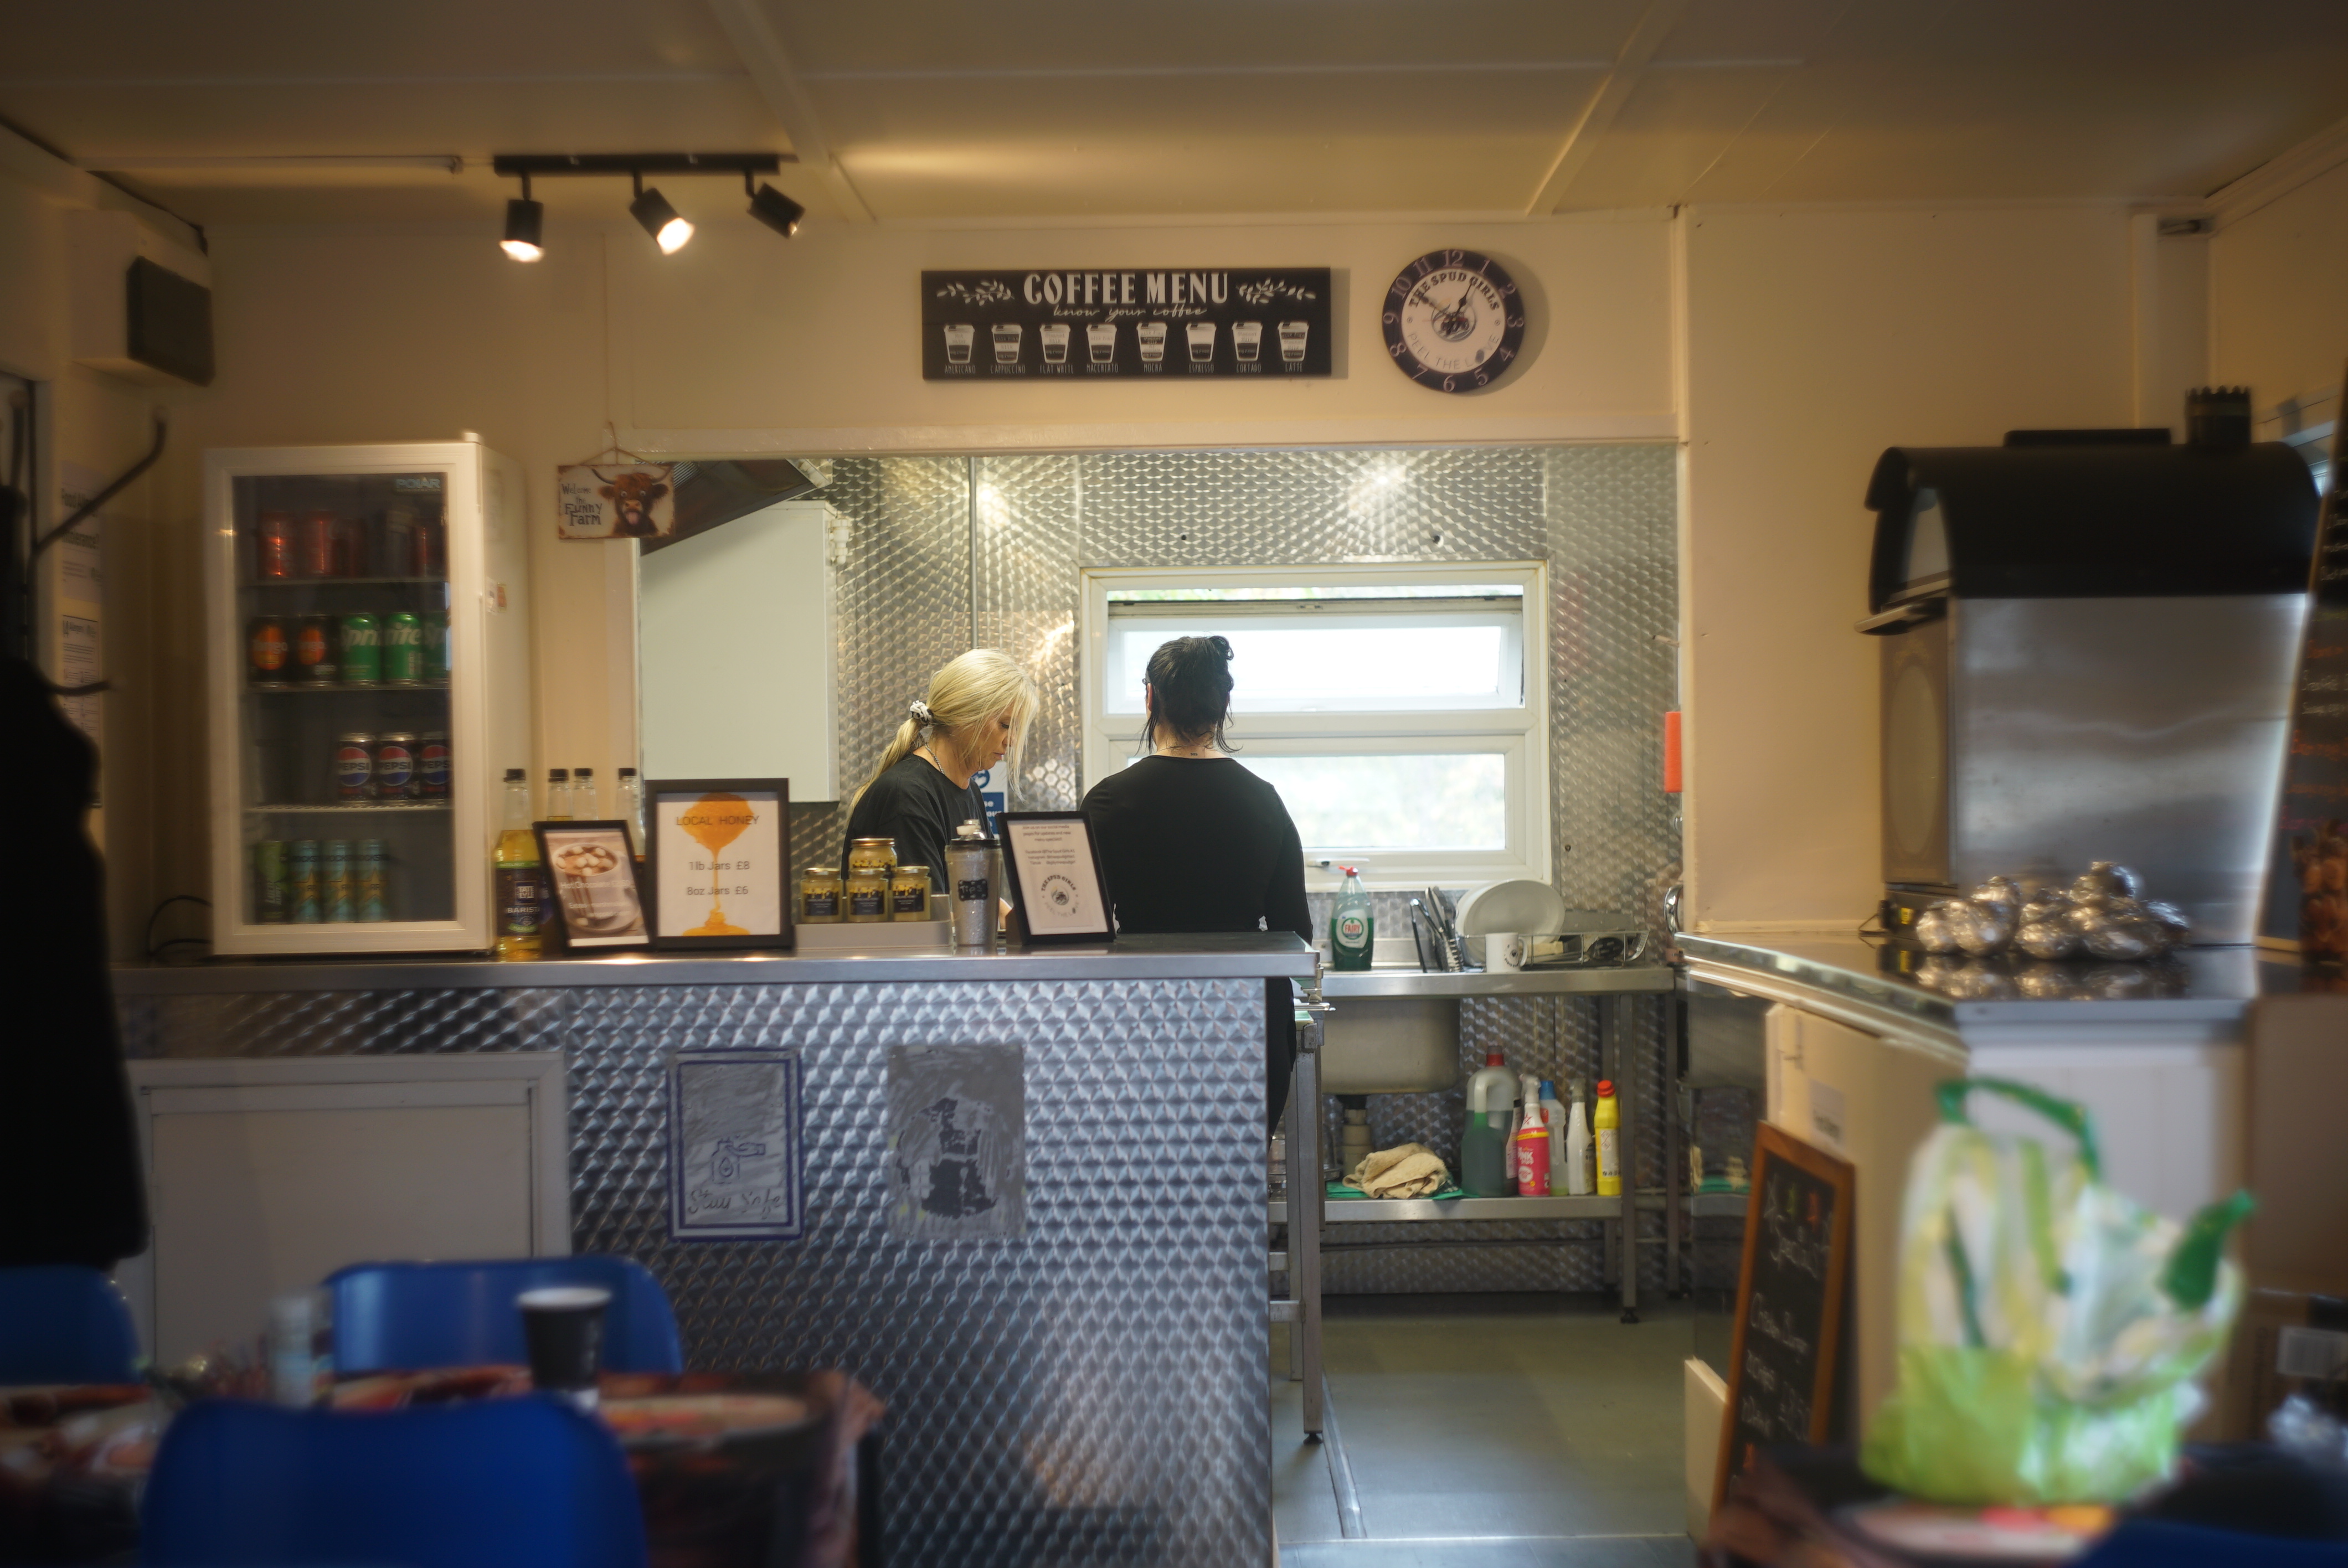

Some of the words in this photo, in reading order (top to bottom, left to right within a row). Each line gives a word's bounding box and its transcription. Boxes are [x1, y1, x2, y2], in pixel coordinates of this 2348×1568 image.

[1442, 249, 1464, 268] 12
[1413, 256, 1434, 278] 11
[1023, 273, 1136, 305] COFFEE
[1146, 272, 1228, 305] MENU
[1391, 277, 1413, 300] 10
[1432, 271, 1468, 286] SPUD
[1469, 275, 1500, 311] GIRLS
[1498, 283, 1516, 300] 2
[1054, 305, 1100, 317] know
[1105, 308, 1146, 322] your
[1152, 303, 1207, 318] coffee
[1382, 313, 1399, 325] 9
[1507, 314, 1525, 328] 3
[1389, 342, 1408, 358] 8
[1500, 347, 1515, 362] 4
[990, 363, 1026, 374] CAPPUCCINO
[1039, 363, 1054, 374] FLAT
[1086, 363, 1119, 373] MACCHIATO
[1143, 363, 1163, 373] MOCHA
[1188, 363, 1214, 373] ESPRESSO
[1236, 363, 1262, 373] CORTADO
[1285, 363, 1303, 373] LATTE
[1435, 355, 1461, 370] THE
[944, 364, 976, 374] AMERICANO
[1443, 374, 1456, 392] 6
[1473, 368, 1489, 387] 5
[395, 476, 441, 488] POLAR
[561, 483, 592, 495] Welcome
[338, 762, 370, 771] PEPSI
[379, 761, 411, 770] PEPSI
[421, 760, 450, 769] PEPS
[676, 816, 712, 826] LOCAL
[719, 815, 760, 825] HONEY
[708, 861, 731, 870] Jars
[737, 861, 750, 870] £8
[687, 886, 704, 896] 8oz
[708, 886, 730, 896] Jars
[735, 886, 749, 896] £6
[1344, 924, 1361, 935] FAIRY
